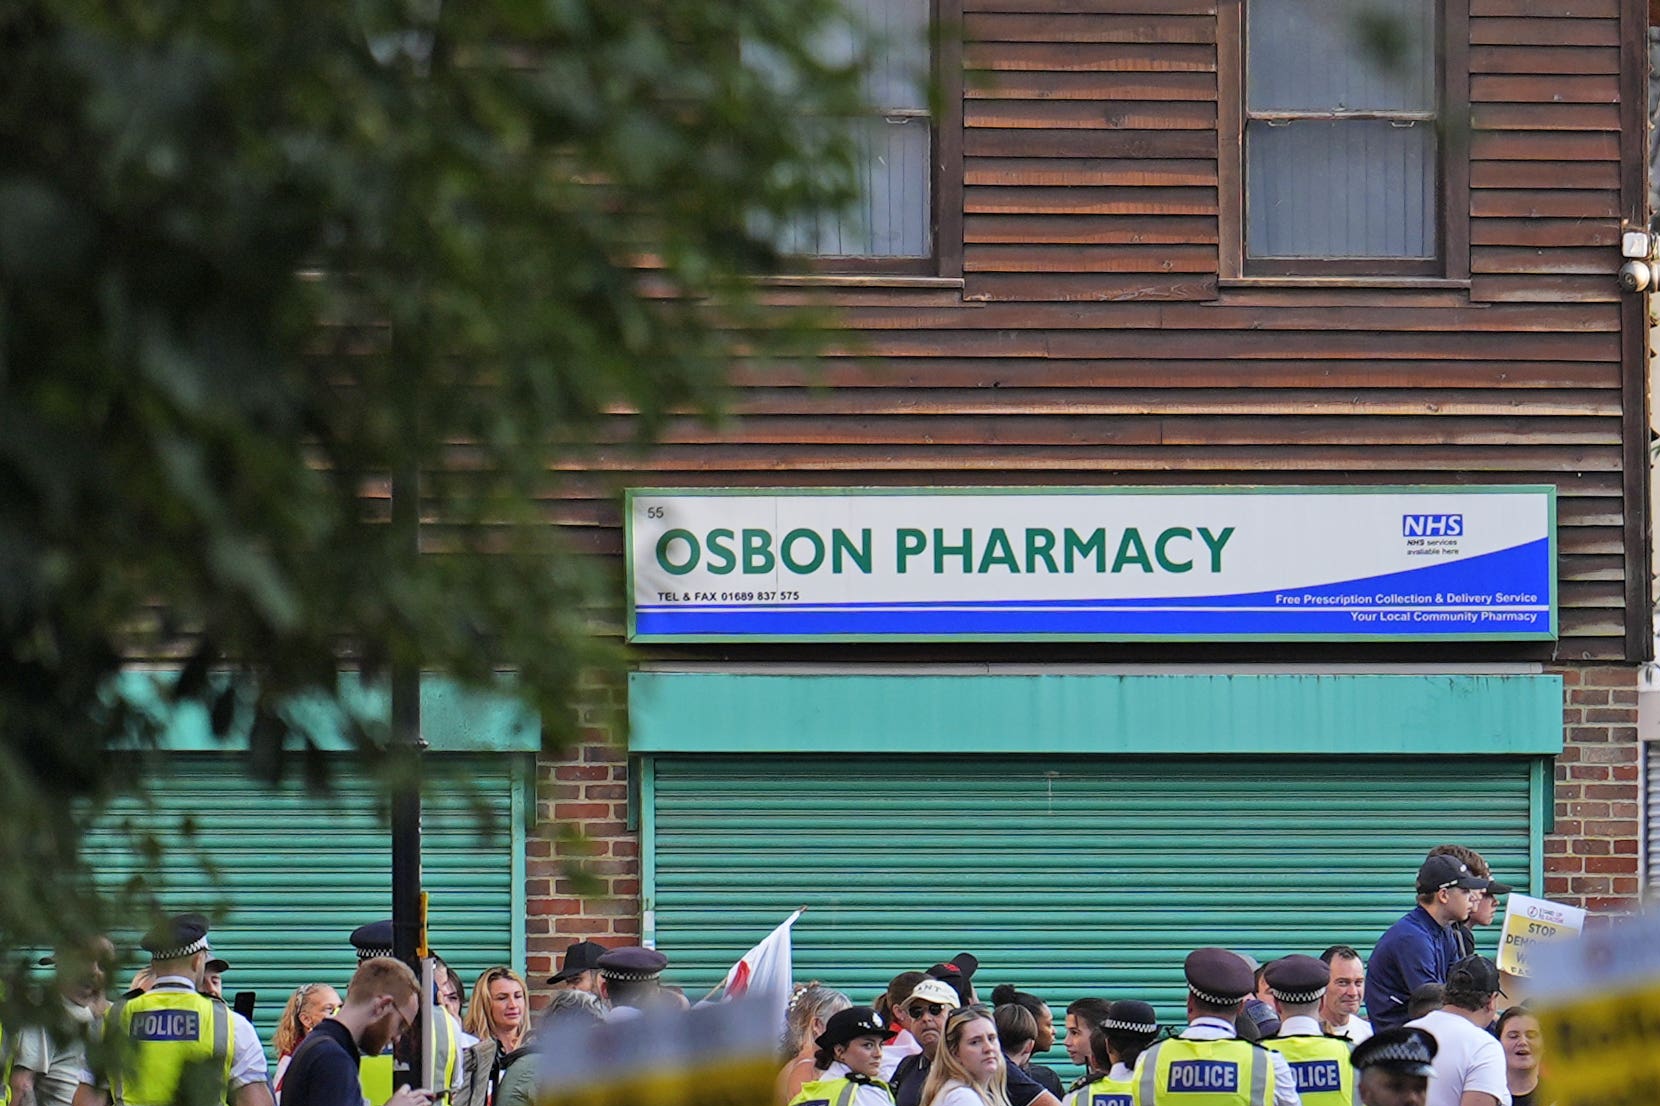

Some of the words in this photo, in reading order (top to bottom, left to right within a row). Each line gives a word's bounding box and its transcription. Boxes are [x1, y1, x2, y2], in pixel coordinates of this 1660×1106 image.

[647, 506, 665, 519] 55
[1404, 515, 1461, 536] NHS
[655, 527, 873, 576] OSBON
[896, 526, 1236, 575] PHARMACY
[657, 592, 679, 602] TEL
[683, 592, 691, 601] &
[694, 592, 717, 601] FAX
[721, 592, 754, 601] 01689
[757, 591, 776, 601] 837
[780, 591, 800, 601] 575
[1275, 594, 1301, 604] Free
[1303, 594, 1372, 606] Prescription
[1375, 593, 1432, 604] Collection
[1435, 592, 1444, 603] &
[1447, 592, 1493, 605] Delivery
[1495, 592, 1538, 603] Service
[1351, 611, 1378, 621] Your
[1380, 611, 1411, 621] Local
[1413, 611, 1478, 623] Community
[1480, 610, 1538, 623] Pharmacy
[1528, 922, 1557, 937] STOP
[1170, 1065, 1235, 1088] POLICE
